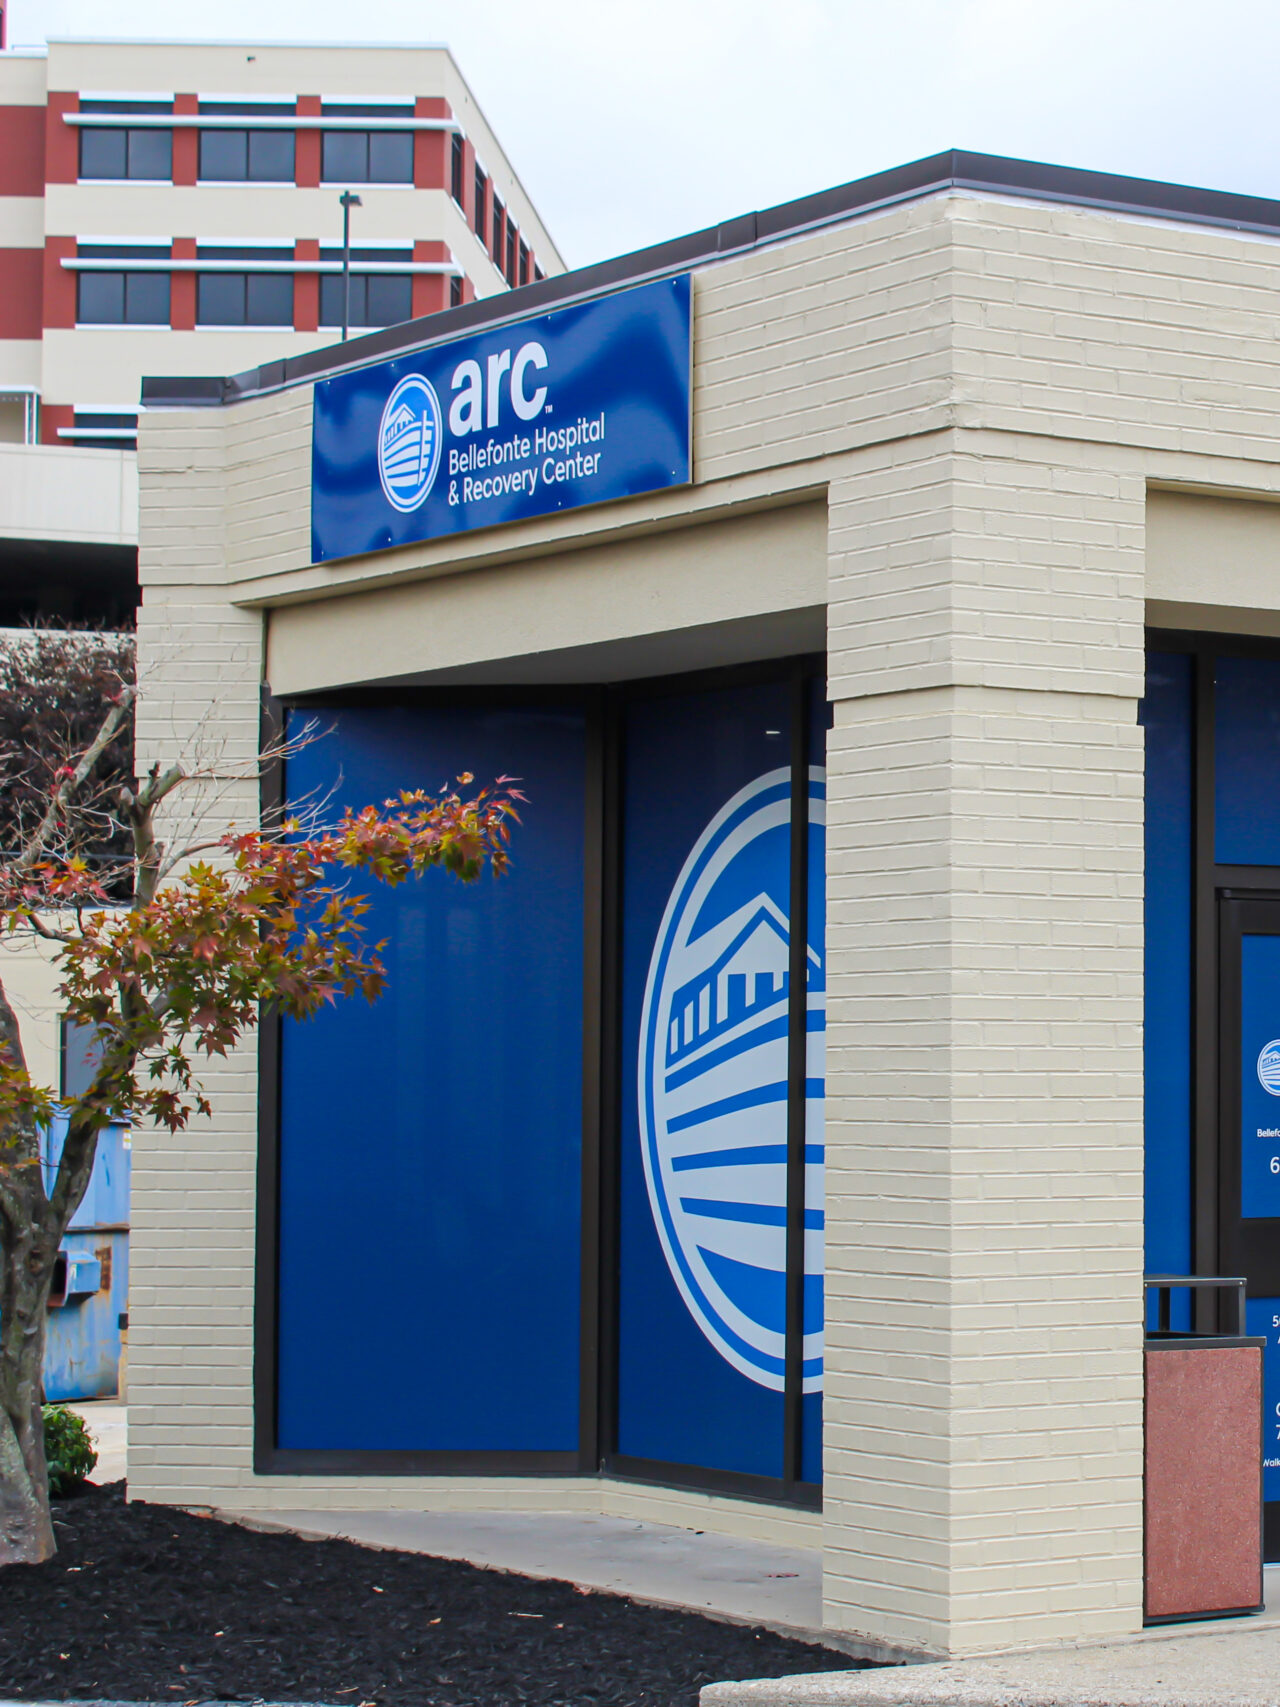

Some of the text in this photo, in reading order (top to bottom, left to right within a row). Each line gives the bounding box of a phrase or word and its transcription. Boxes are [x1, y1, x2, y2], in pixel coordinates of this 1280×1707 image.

[449, 342, 548, 437] arc
[449, 412, 604, 475] Bellefonte Hospital
[448, 451, 601, 506] & Recovery Center
